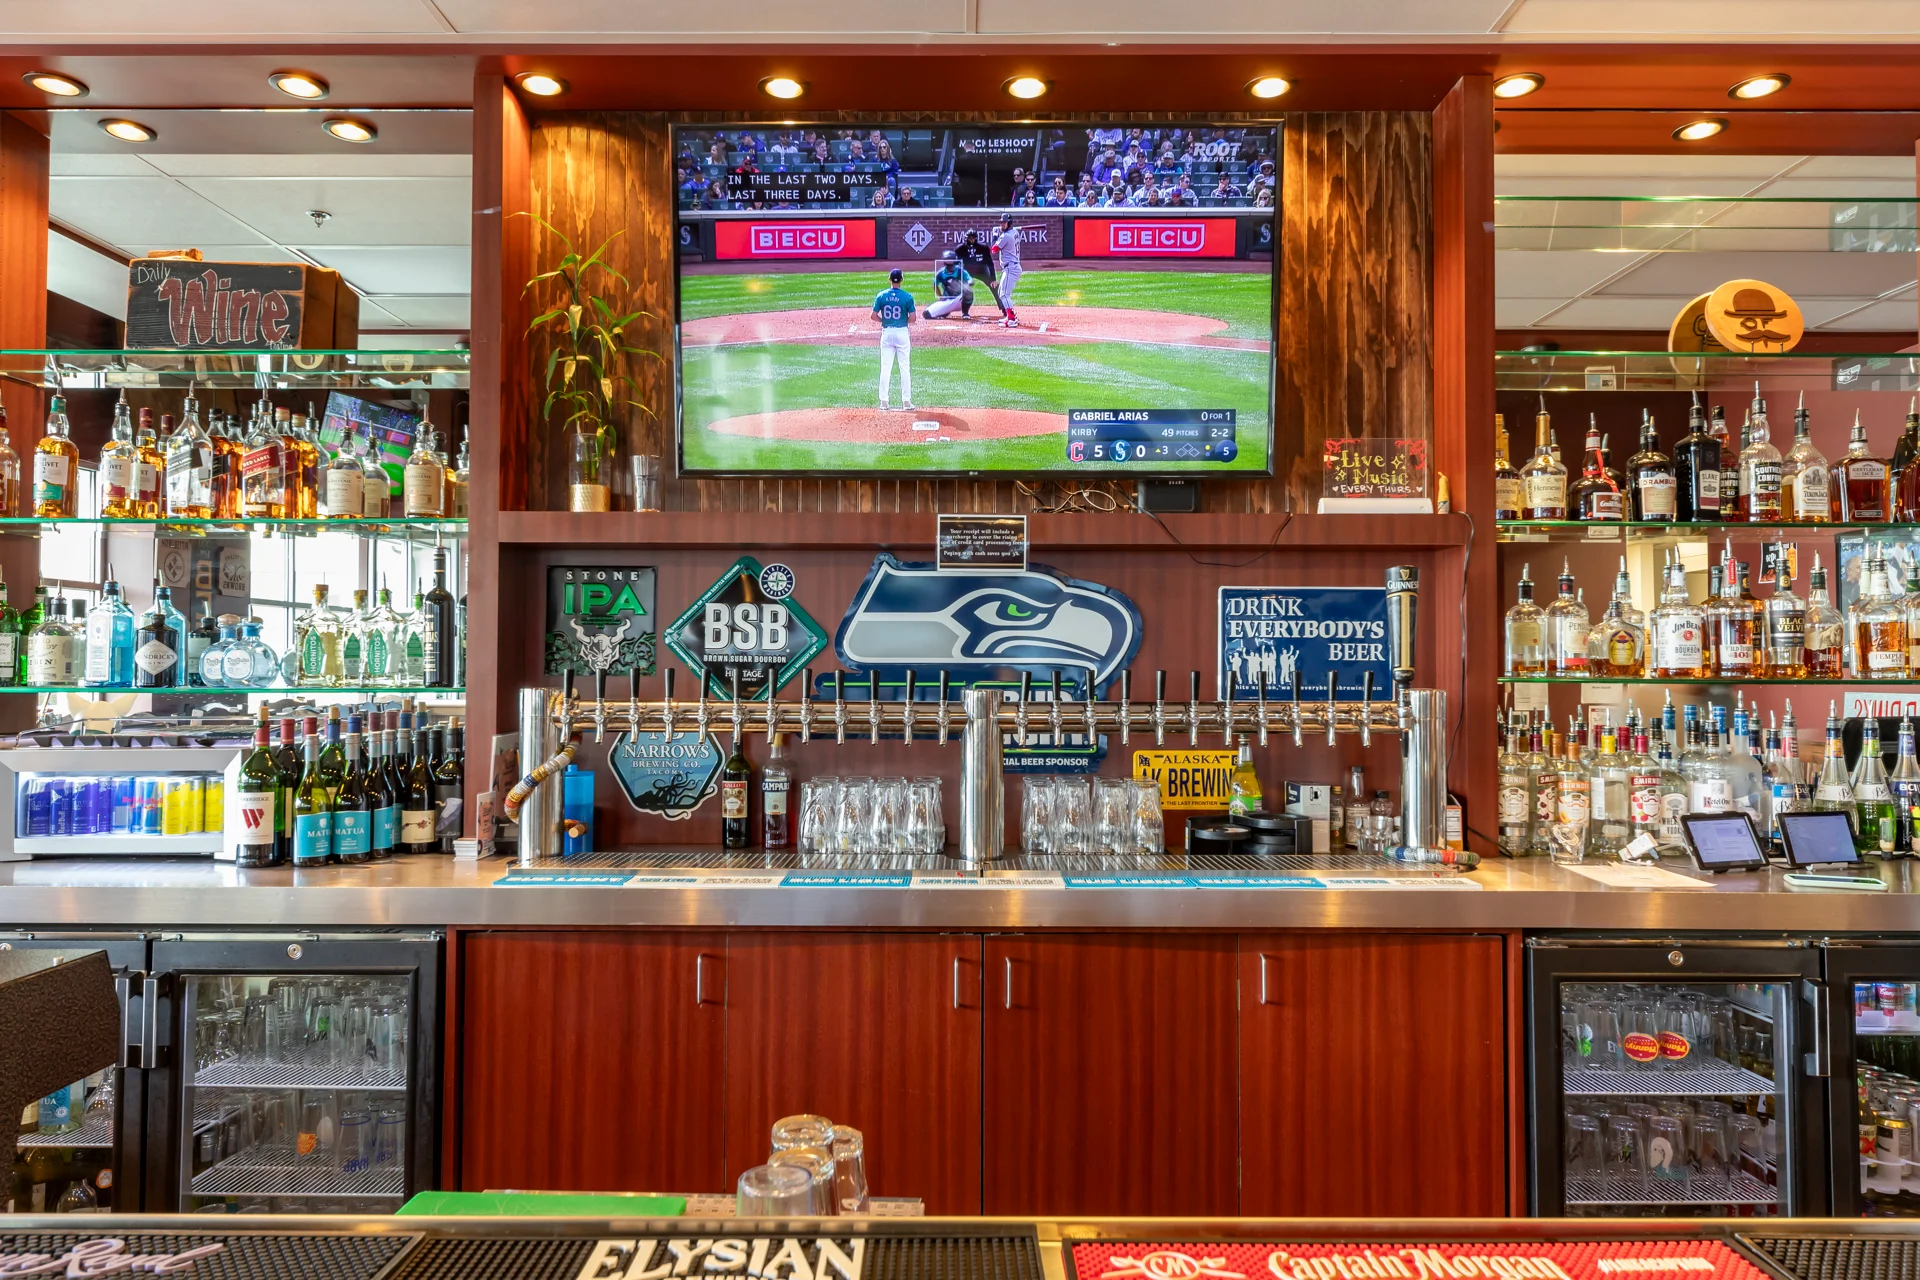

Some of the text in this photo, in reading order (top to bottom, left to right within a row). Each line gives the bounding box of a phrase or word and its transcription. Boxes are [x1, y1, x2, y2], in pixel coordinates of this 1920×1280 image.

[1193, 143, 1242, 156] ROOT
[728, 174, 878, 186] IN THE LAST TWO DAYS.
[728, 188, 842, 200] LAST THREE DAYS.
[137, 263, 171, 284] Daily
[158, 269, 290, 346] Wine
[884, 305, 901, 319] 68
[1073, 412, 1149, 421] GABRIEL ARIAS
[1201, 412, 1208, 421] 0
[1225, 412, 1230, 421] 1
[1162, 429, 1174, 437] 49
[1211, 429, 1228, 437] 2-2
[1094, 445, 1103, 457] 5
[1136, 445, 1146, 457] 0
[1162, 446, 1168, 454] 3
[1223, 447, 1229, 455] 5
[254, 454, 271, 464] LABEL
[1341, 450, 1385, 468] Live
[1353, 469, 1409, 485] Music
[1340, 485, 1374, 493] EVERY
[566, 571, 638, 580] STONE
[564, 583, 647, 615] IPA
[1229, 598, 1304, 616] DRINK
[704, 602, 788, 651] BSB
[1229, 620, 1385, 639] EVERYBODY'S
[1672, 621, 1685, 633] JIM
[1328, 643, 1385, 661] BEER
[622, 744, 709, 759] NARROWS
[1163, 755, 1222, 764] ALASKA
[1168, 768, 1232, 797] BREWIN
[577, 1238, 865, 1280] ELYSIAN
[1268, 1249, 1572, 1280] Captain Morgan
